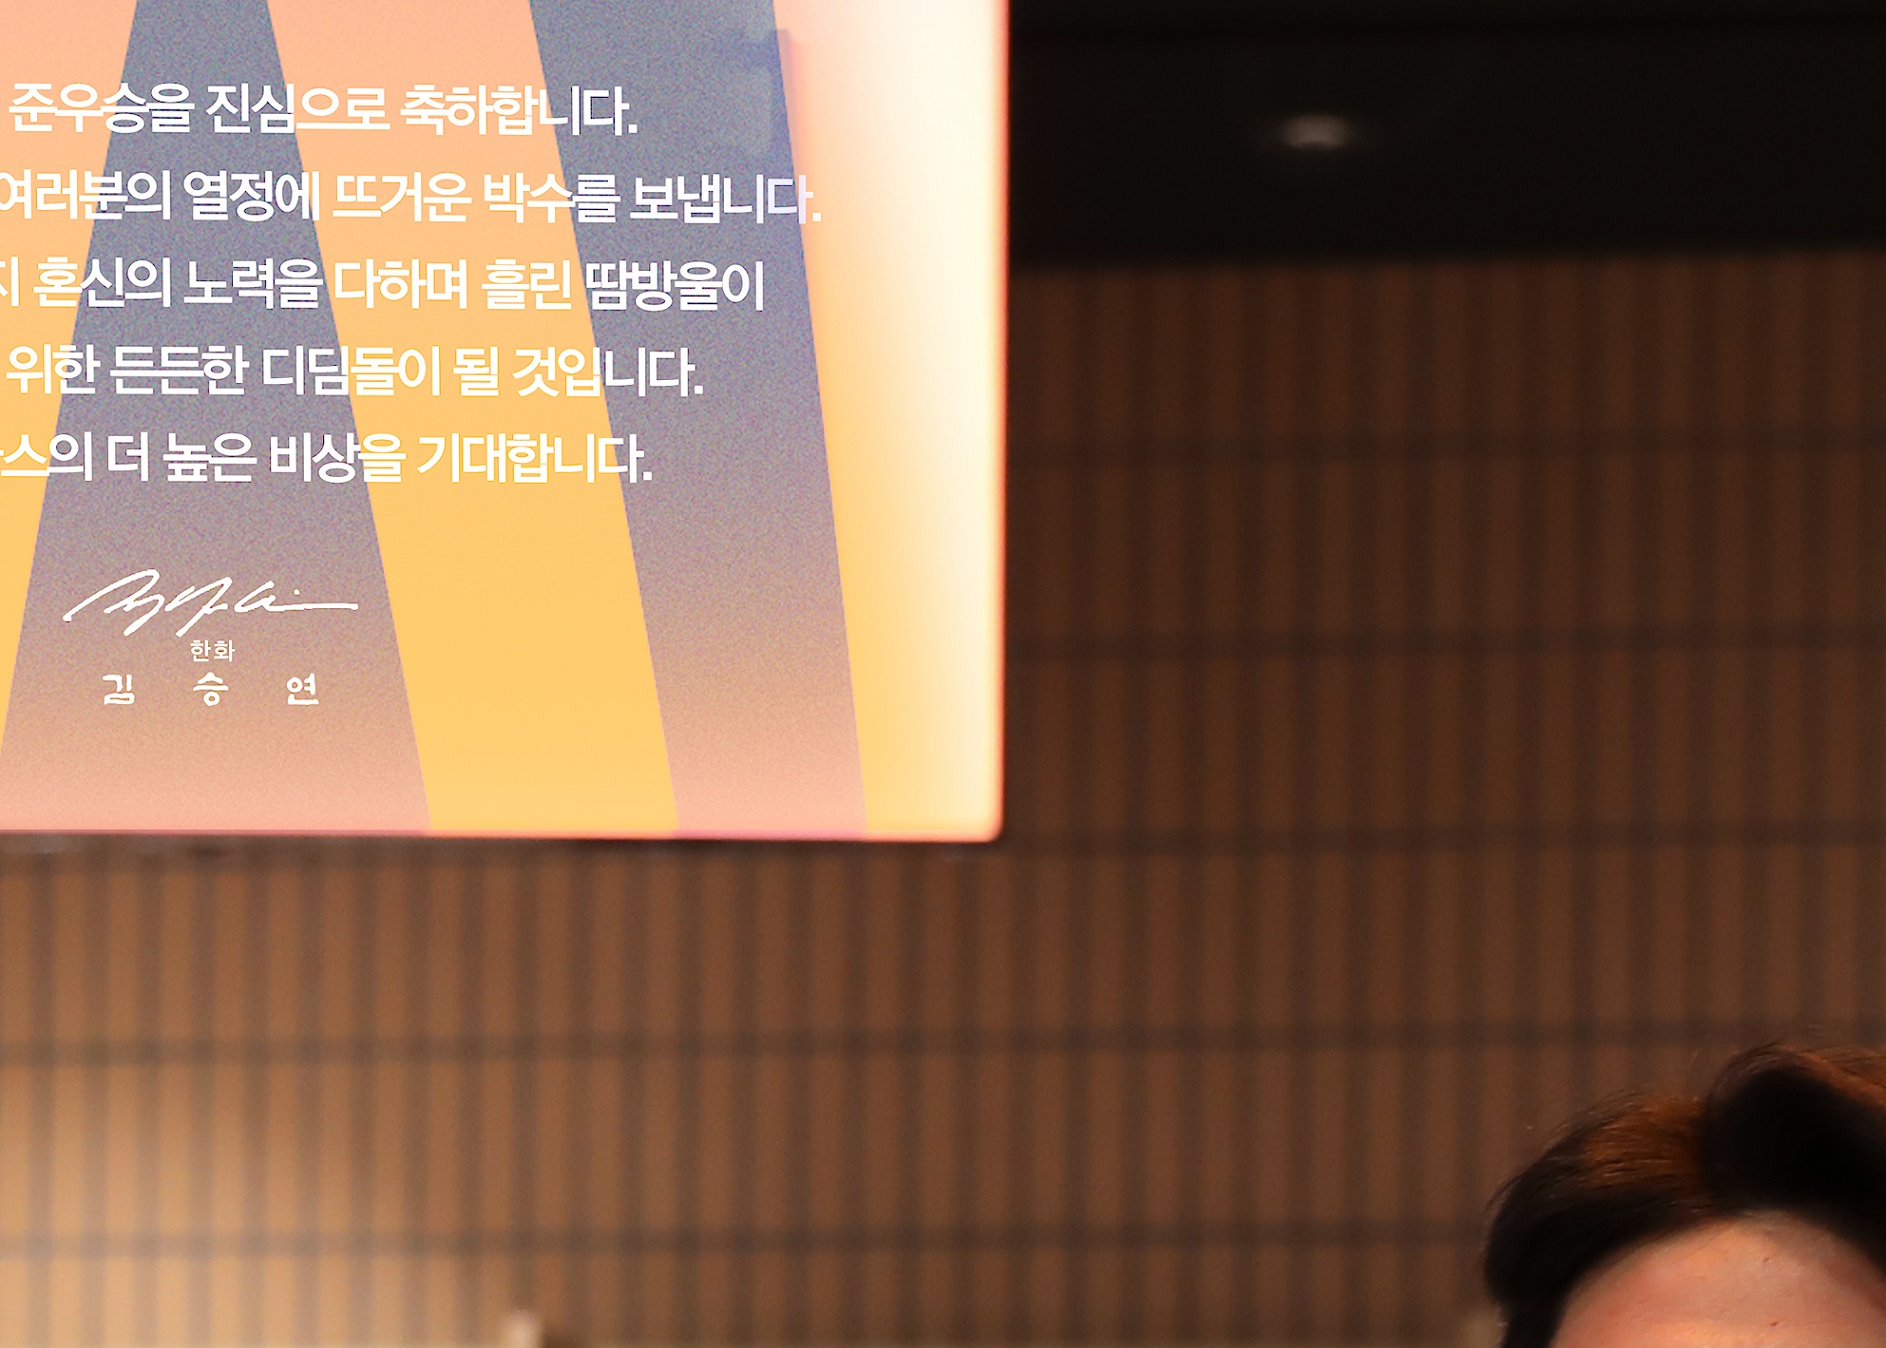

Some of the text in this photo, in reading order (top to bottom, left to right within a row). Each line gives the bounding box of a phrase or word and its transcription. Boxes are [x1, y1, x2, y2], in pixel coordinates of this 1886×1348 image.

[9, 82, 195, 134] 준우승을
[207, 83, 390, 134] 진심으로
[400, 85, 638, 136] 축하합니다.
[183, 170, 320, 222] 열정에
[333, 172, 472, 222] 뜨거운
[484, 172, 621, 223] 박수를
[630, 174, 822, 224] 보냅니다.
[34, 257, 171, 308] 혼신의
[183, 258, 324, 309] 노력을
[335, 259, 467, 309] 다하며
[482, 259, 572, 310] 흘린
[586, 260, 764, 312] 땀방울이
[6, 344, 101, 394] 위한
[110, 345, 250, 395] 든든한
[263, 345, 440, 396] 디딤돌이
[453, 346, 499, 396] 될
[514, 347, 704, 397] 것입니다.
[107, 431, 149, 482] 더
[163, 432, 258, 482] 높은
[270, 432, 406, 483] 비상을
[419, 433, 652, 483] 기대합니다.
[189, 639, 236, 662] 한화
